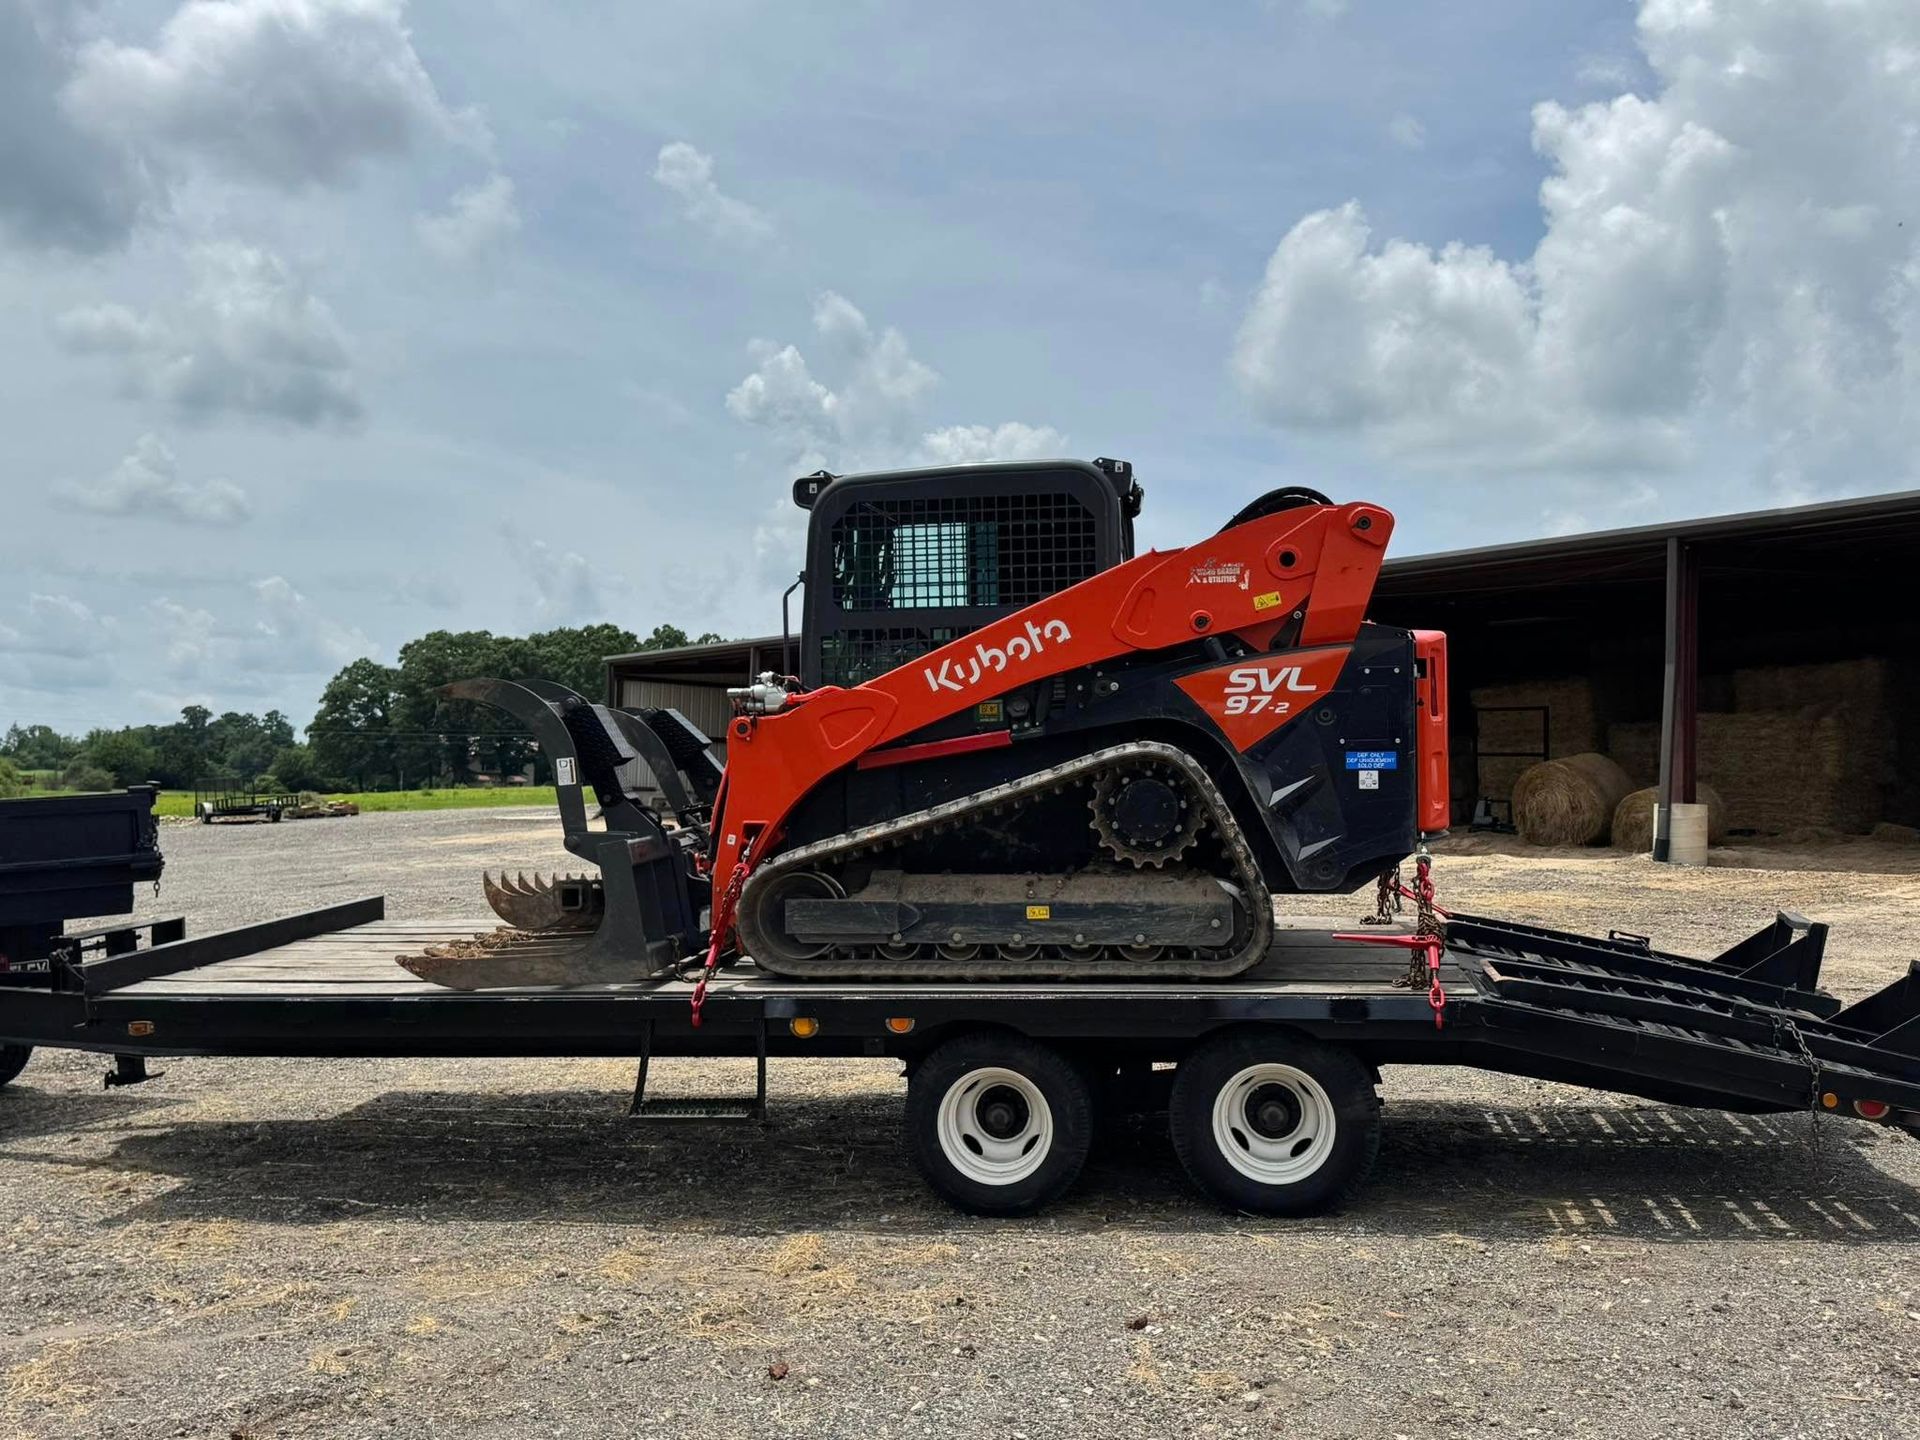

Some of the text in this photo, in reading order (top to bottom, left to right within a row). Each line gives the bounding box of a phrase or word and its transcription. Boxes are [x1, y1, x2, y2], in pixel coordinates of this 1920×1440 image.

[923, 619, 1072, 692] Kubota
[1223, 667, 1317, 694] SVL
[1223, 695, 1290, 715] 97-2
